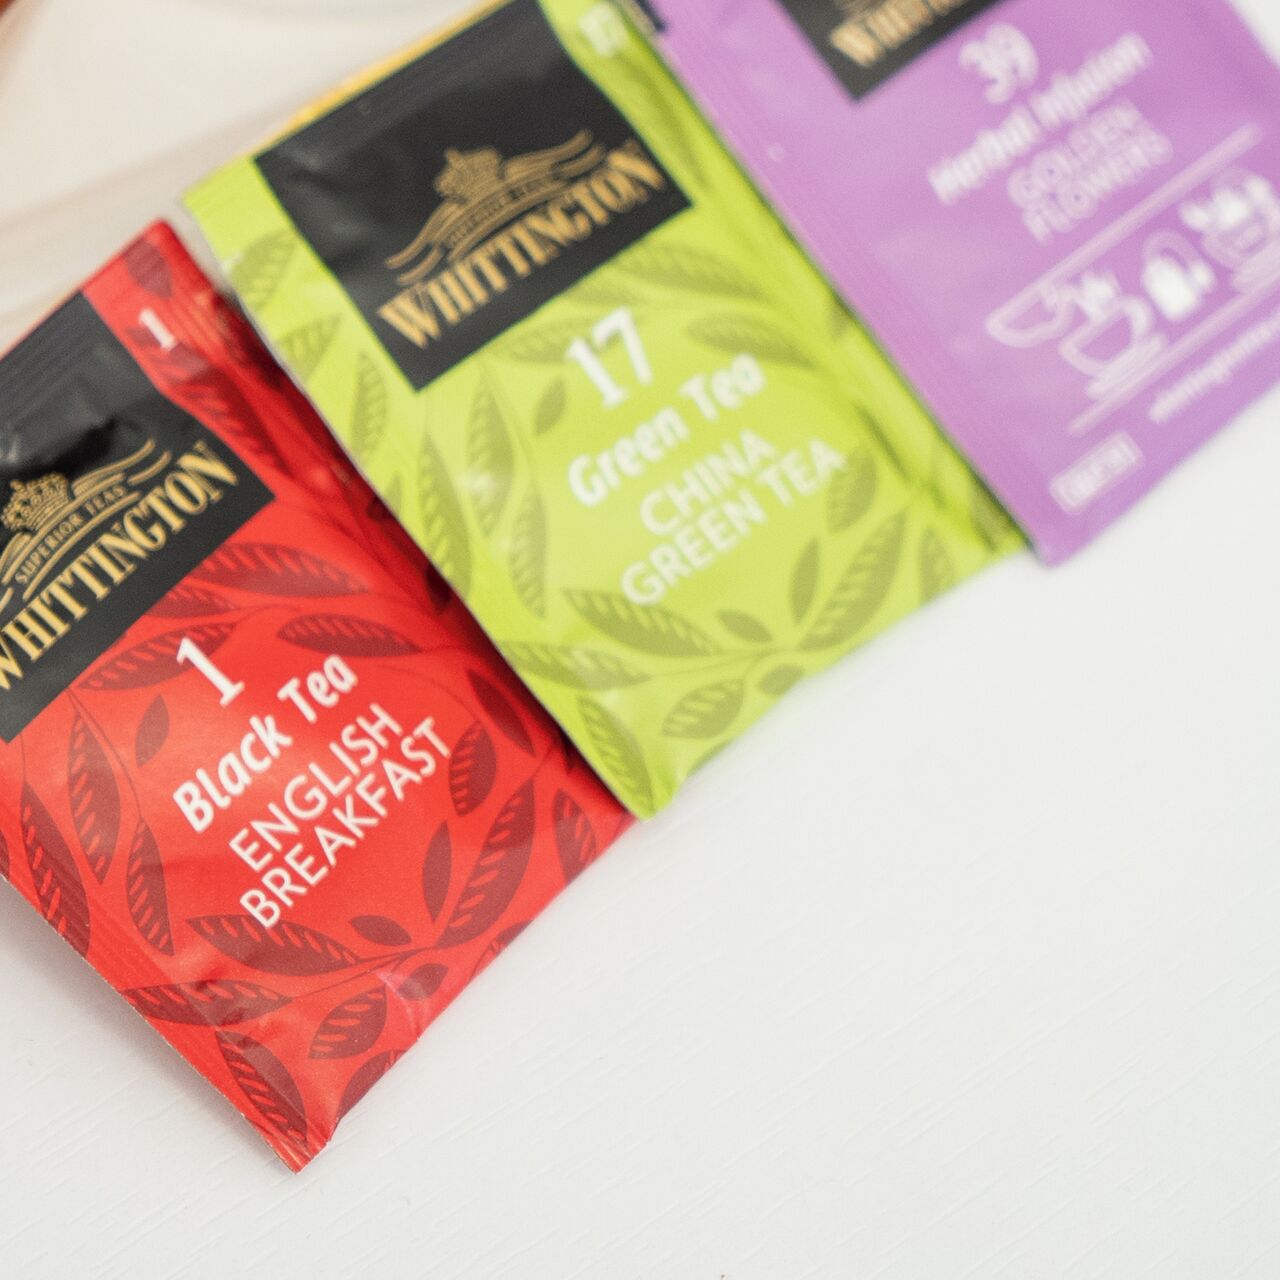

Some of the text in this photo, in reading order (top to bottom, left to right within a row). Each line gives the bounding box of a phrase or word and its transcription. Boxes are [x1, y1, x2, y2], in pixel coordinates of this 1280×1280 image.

[377, 139, 664, 348] WHITTINGTON
[138, 308, 176, 352] 1
[566, 305, 653, 409] 17
[568, 352, 766, 507] Green Tea
[640, 429, 777, 536] CHINA
[14, 485, 127, 584] SUPERIOR TEAS
[620, 437, 847, 605] GREEN TEA
[172, 653, 358, 833] Black Tea
[176, 636, 245, 707] 1
[228, 703, 404, 872] ENGLISH
[239, 716, 452, 929] BREAKFAST
